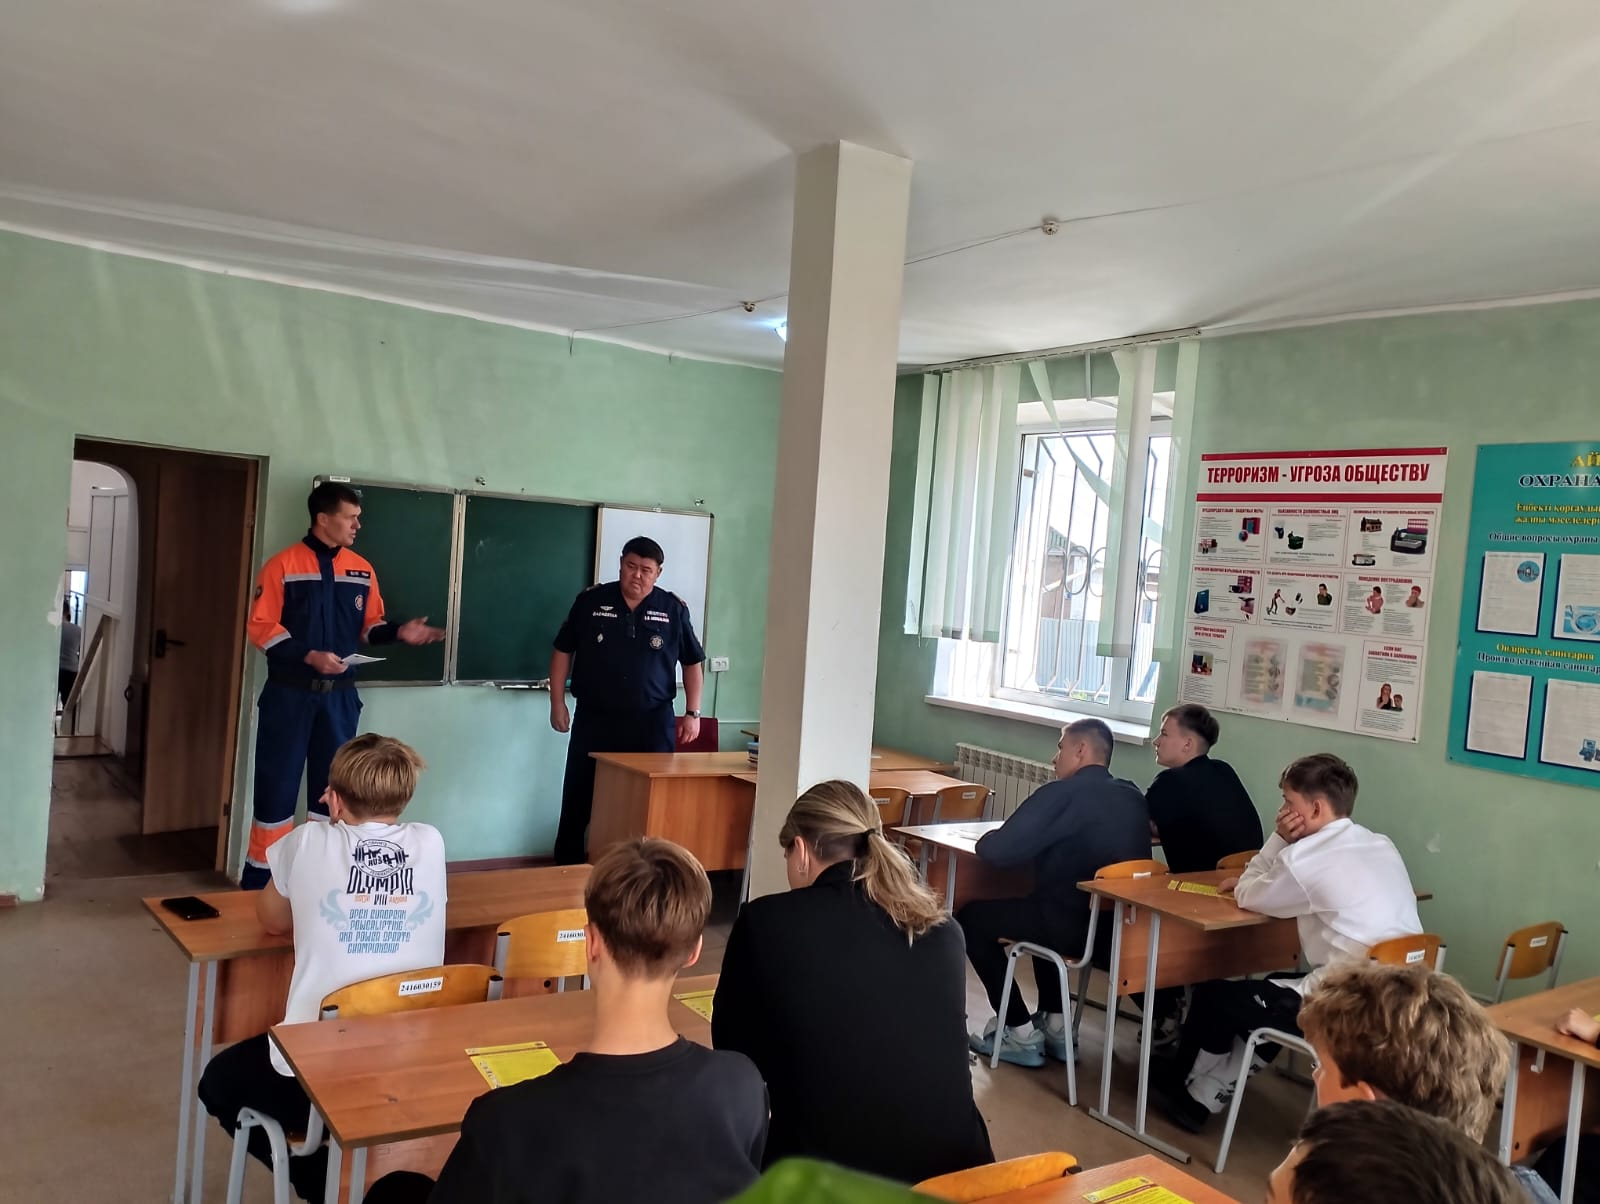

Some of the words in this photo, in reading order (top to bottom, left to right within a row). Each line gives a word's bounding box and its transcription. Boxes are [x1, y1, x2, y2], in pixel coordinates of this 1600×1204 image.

[1207, 466, 1279, 483] ТЕРРОРИЗМ
[1290, 464, 1341, 483] УГРОЗА
[1344, 463, 1430, 485] ОБЩЕСТВУ
[1489, 532, 1520, 542] Общие
[1522, 534, 1560, 544] вопросы
[1562, 535, 1598, 544] охраны
[346, 865, 414, 895] OLYMPIA
